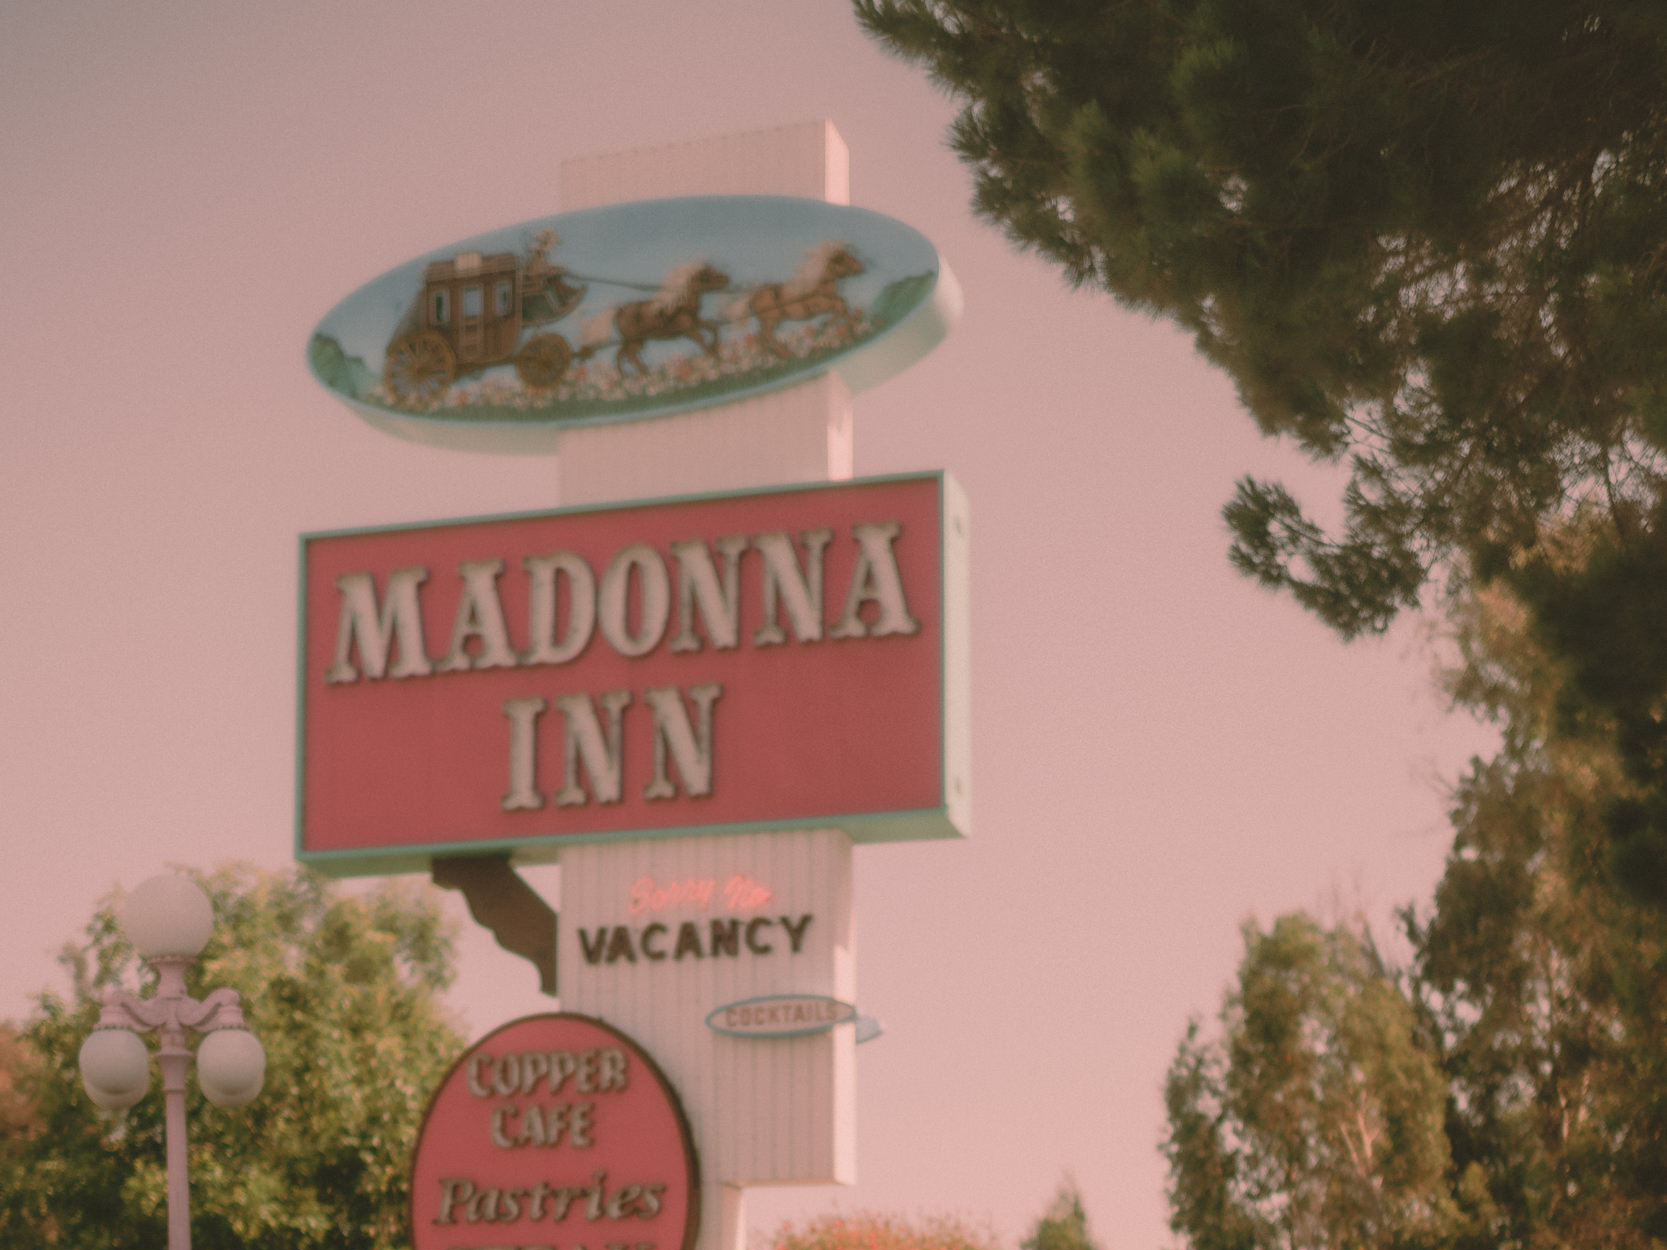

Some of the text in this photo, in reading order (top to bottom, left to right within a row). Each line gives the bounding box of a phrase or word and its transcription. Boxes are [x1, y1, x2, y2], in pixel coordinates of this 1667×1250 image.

[325, 520, 920, 684] MADONNA
[501, 681, 723, 811] INN
[577, 913, 813, 965] VACANCY
[725, 1001, 838, 1028] COCKTAILS
[467, 1048, 628, 1098] COPPER
[491, 1101, 596, 1149] CAFE
[433, 1169, 667, 1225] Pastries
